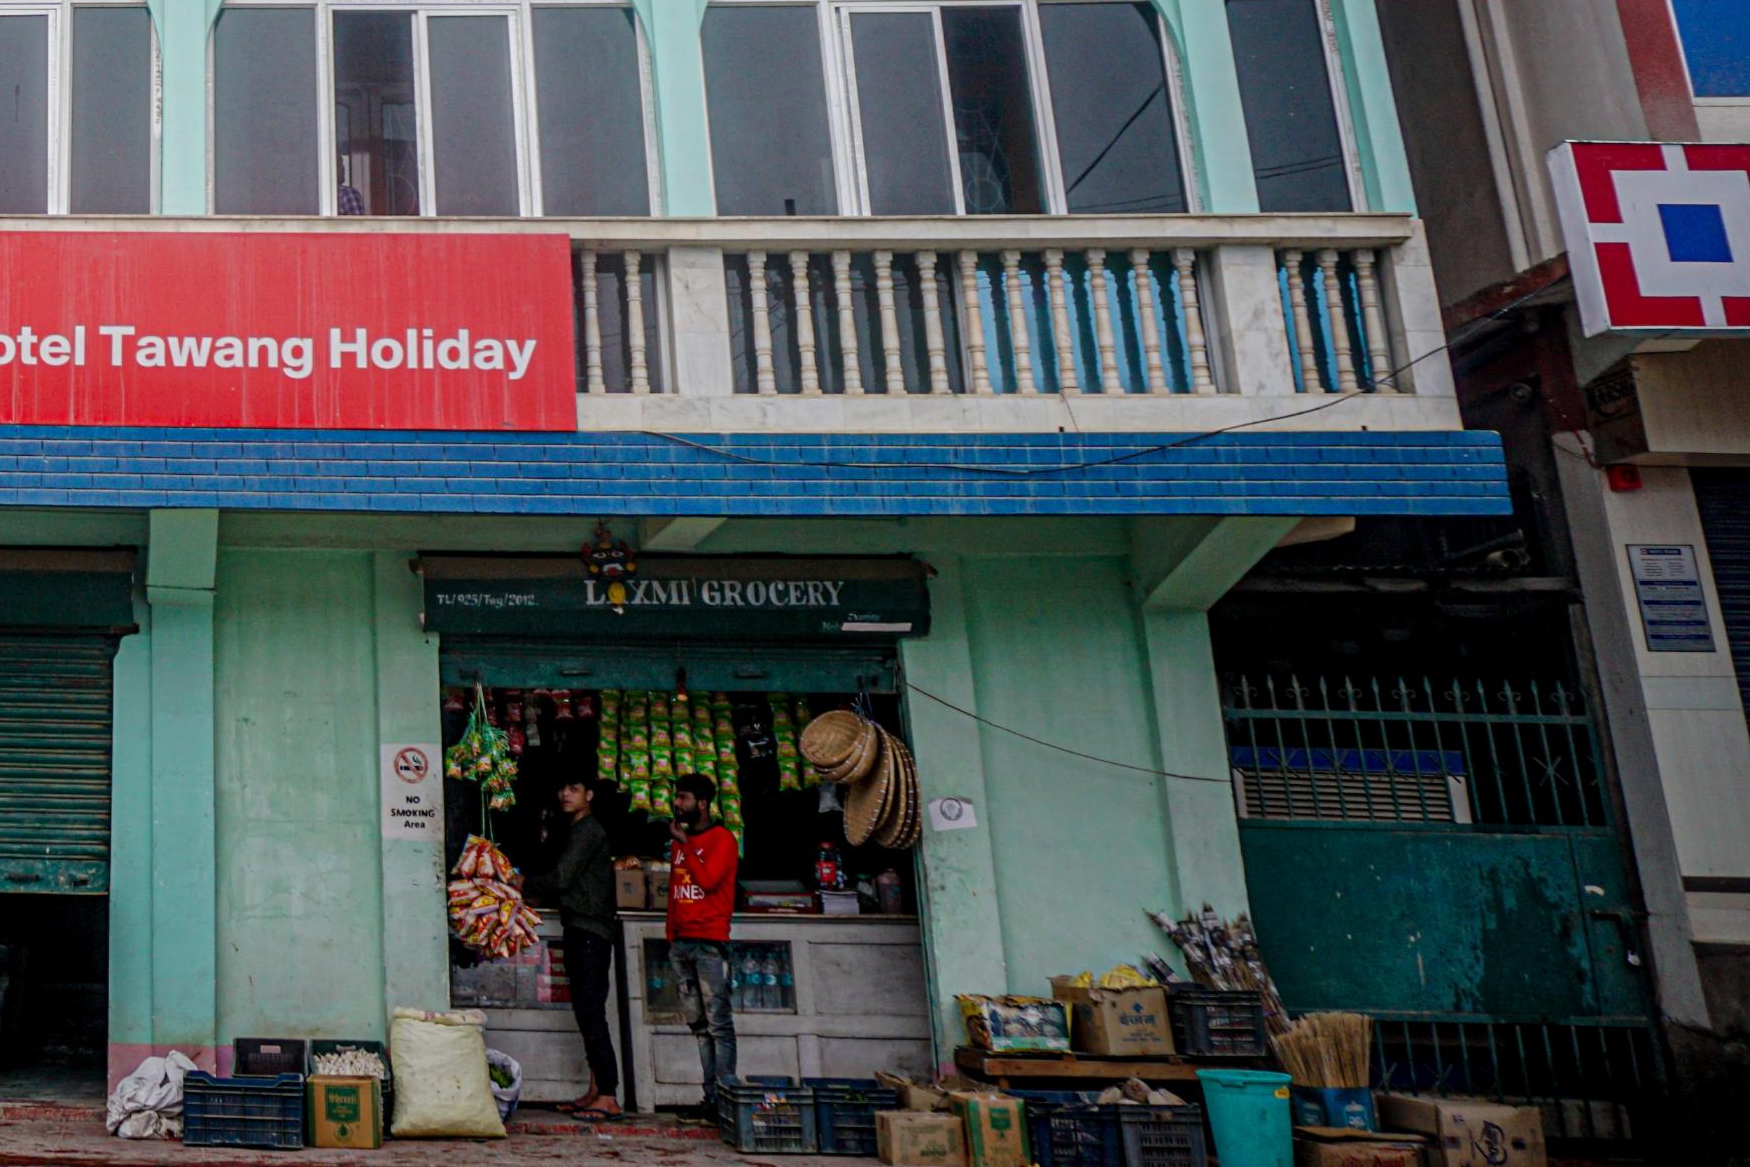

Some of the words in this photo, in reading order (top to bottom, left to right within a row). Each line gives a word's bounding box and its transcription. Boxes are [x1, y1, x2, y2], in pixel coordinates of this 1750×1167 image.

[99, 325, 314, 379] Tawang
[329, 327, 537, 380] Holiday
[583, 579, 692, 606] LXMI
[702, 580, 844, 606] GROCERY
[406, 796, 420, 804] NO
[390, 808, 435, 818] SMOKING
[404, 820, 426, 829] Area
